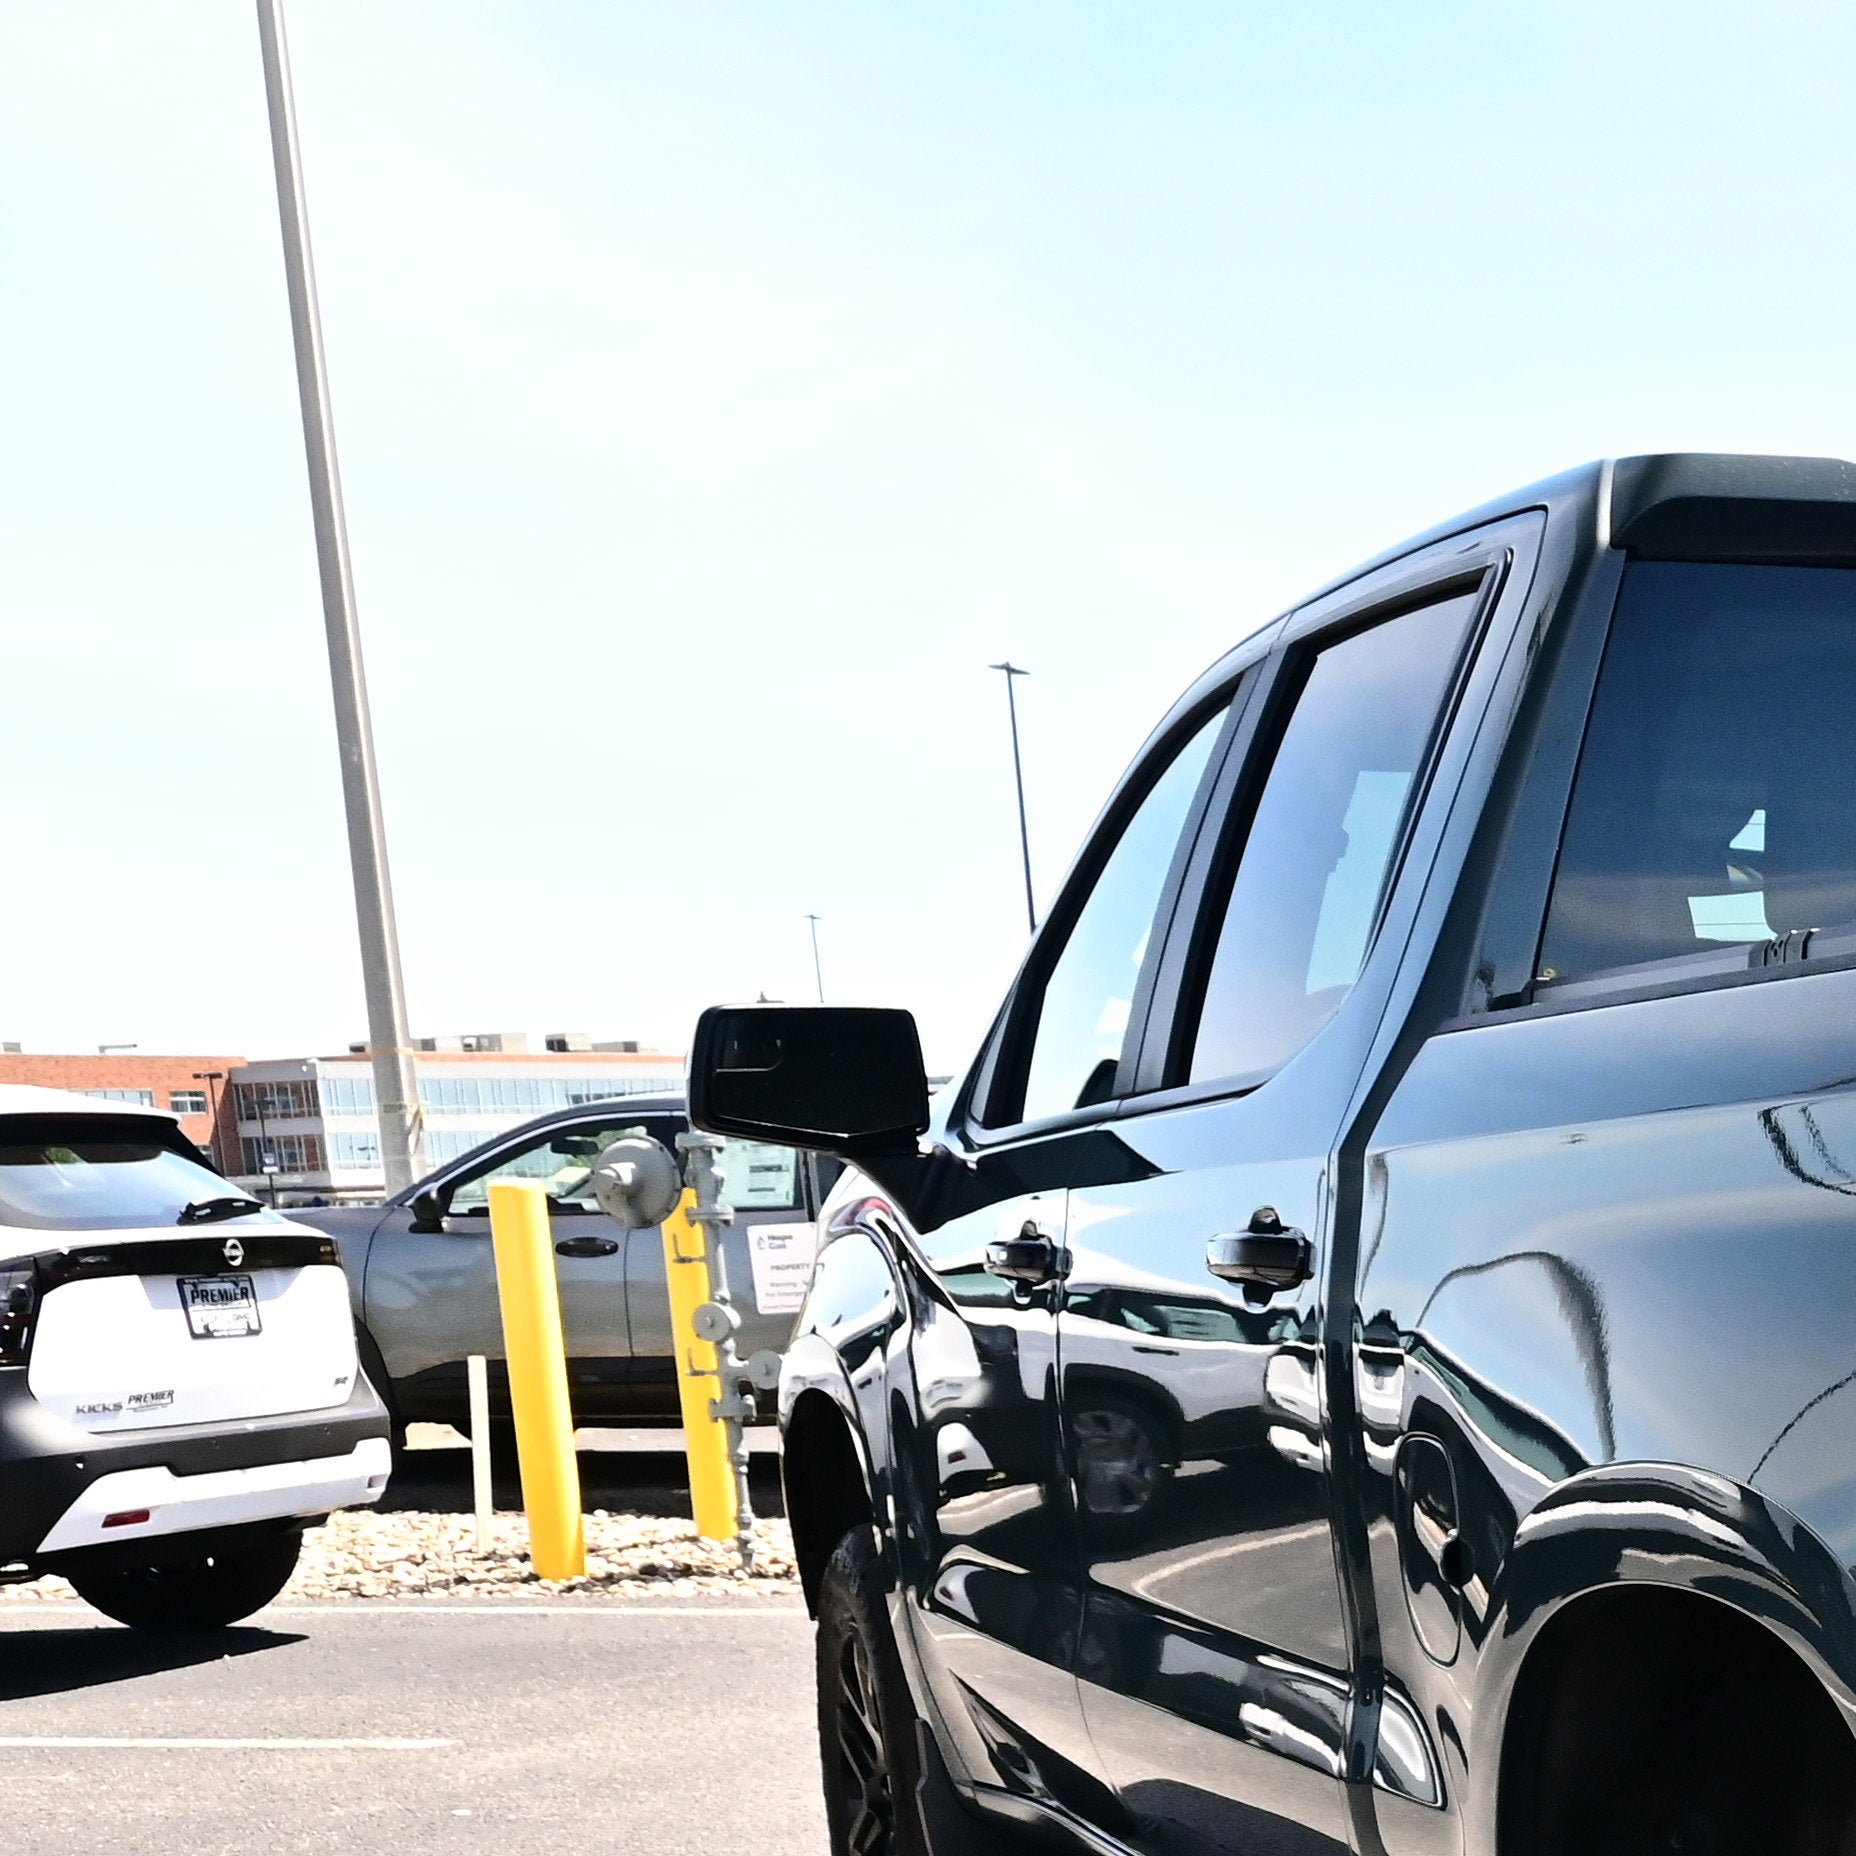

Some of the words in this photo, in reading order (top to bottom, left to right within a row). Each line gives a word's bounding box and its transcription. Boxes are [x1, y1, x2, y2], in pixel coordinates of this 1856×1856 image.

[190, 1287, 250, 1304] PREMIER
[128, 1389, 175, 1405] PREMIER
[75, 1402, 123, 1415] KICKS
